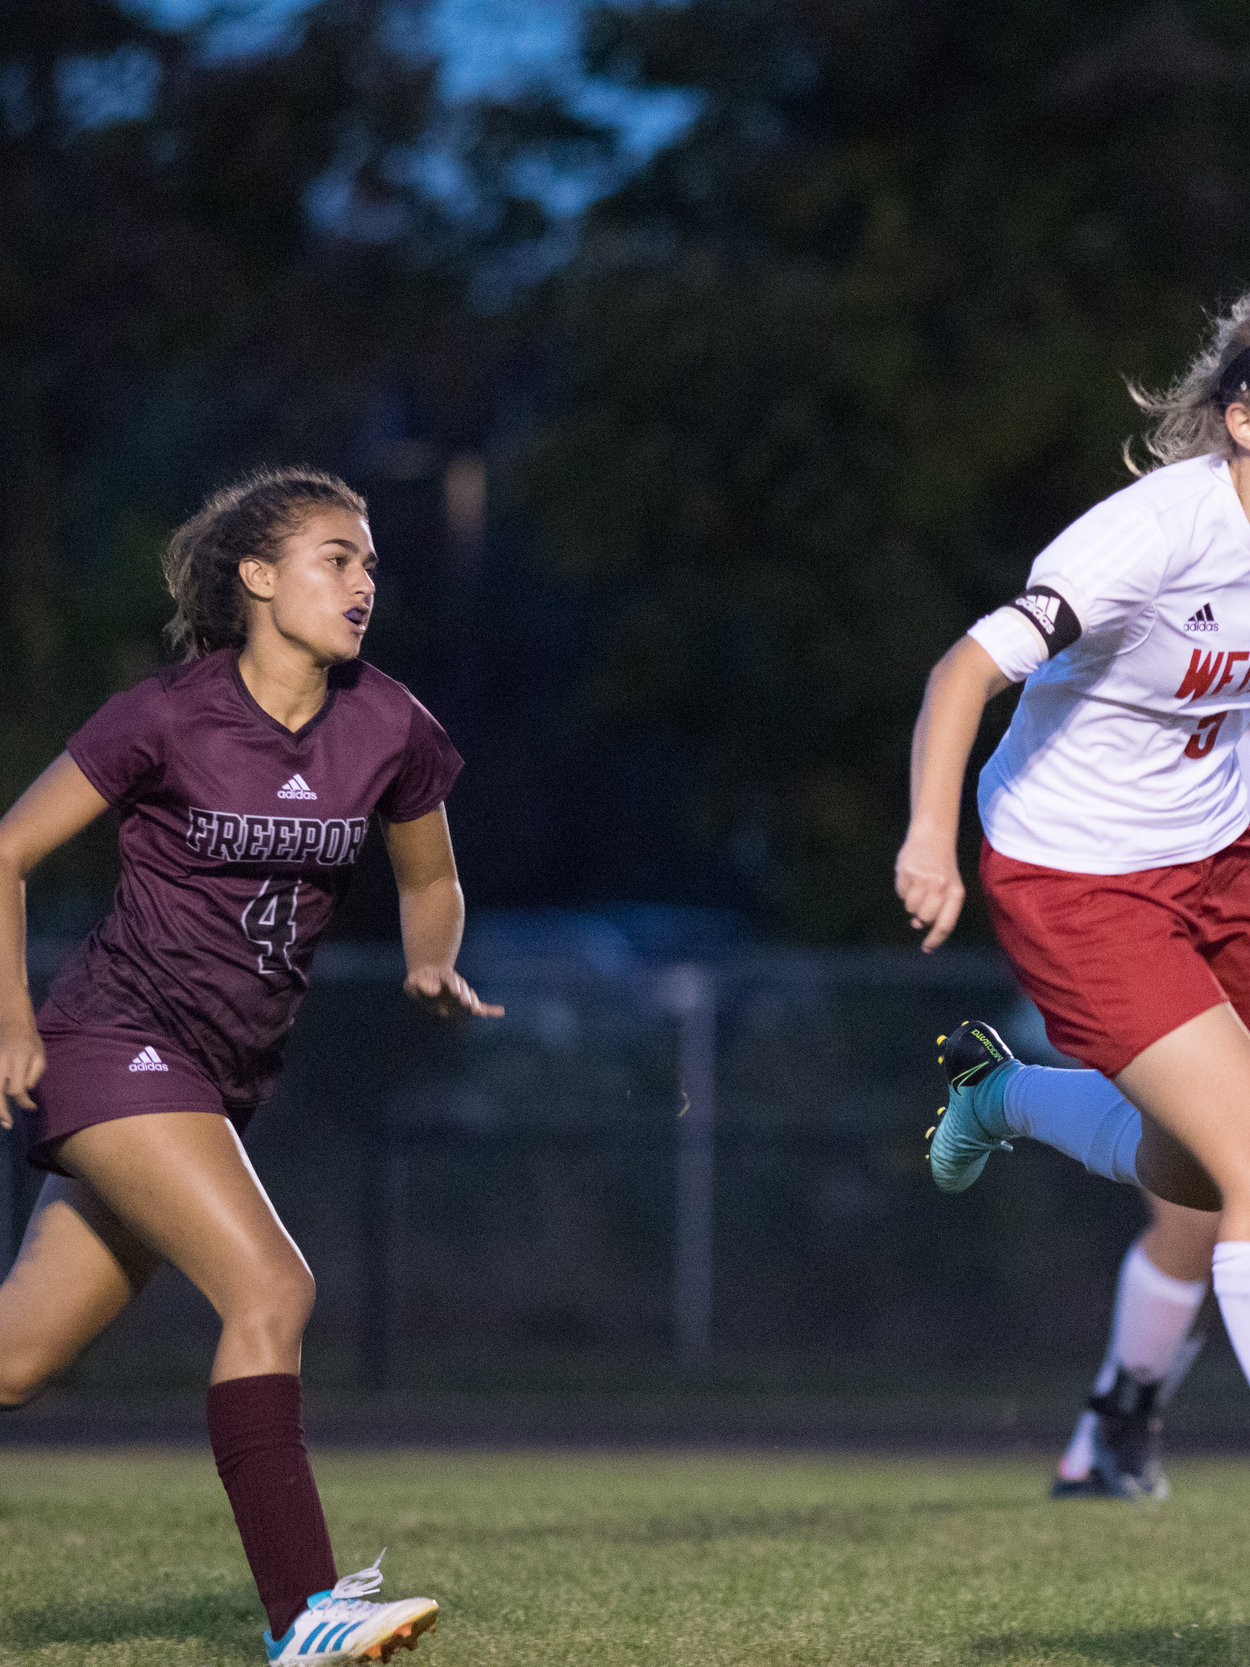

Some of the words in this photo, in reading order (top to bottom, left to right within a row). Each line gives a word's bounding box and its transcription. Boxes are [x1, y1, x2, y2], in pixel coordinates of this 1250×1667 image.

[1184, 620, 1219, 631] adidas
[277, 789, 318, 800] adidas
[241, 874, 308, 979] 4
[128, 1062, 169, 1072] adidas
